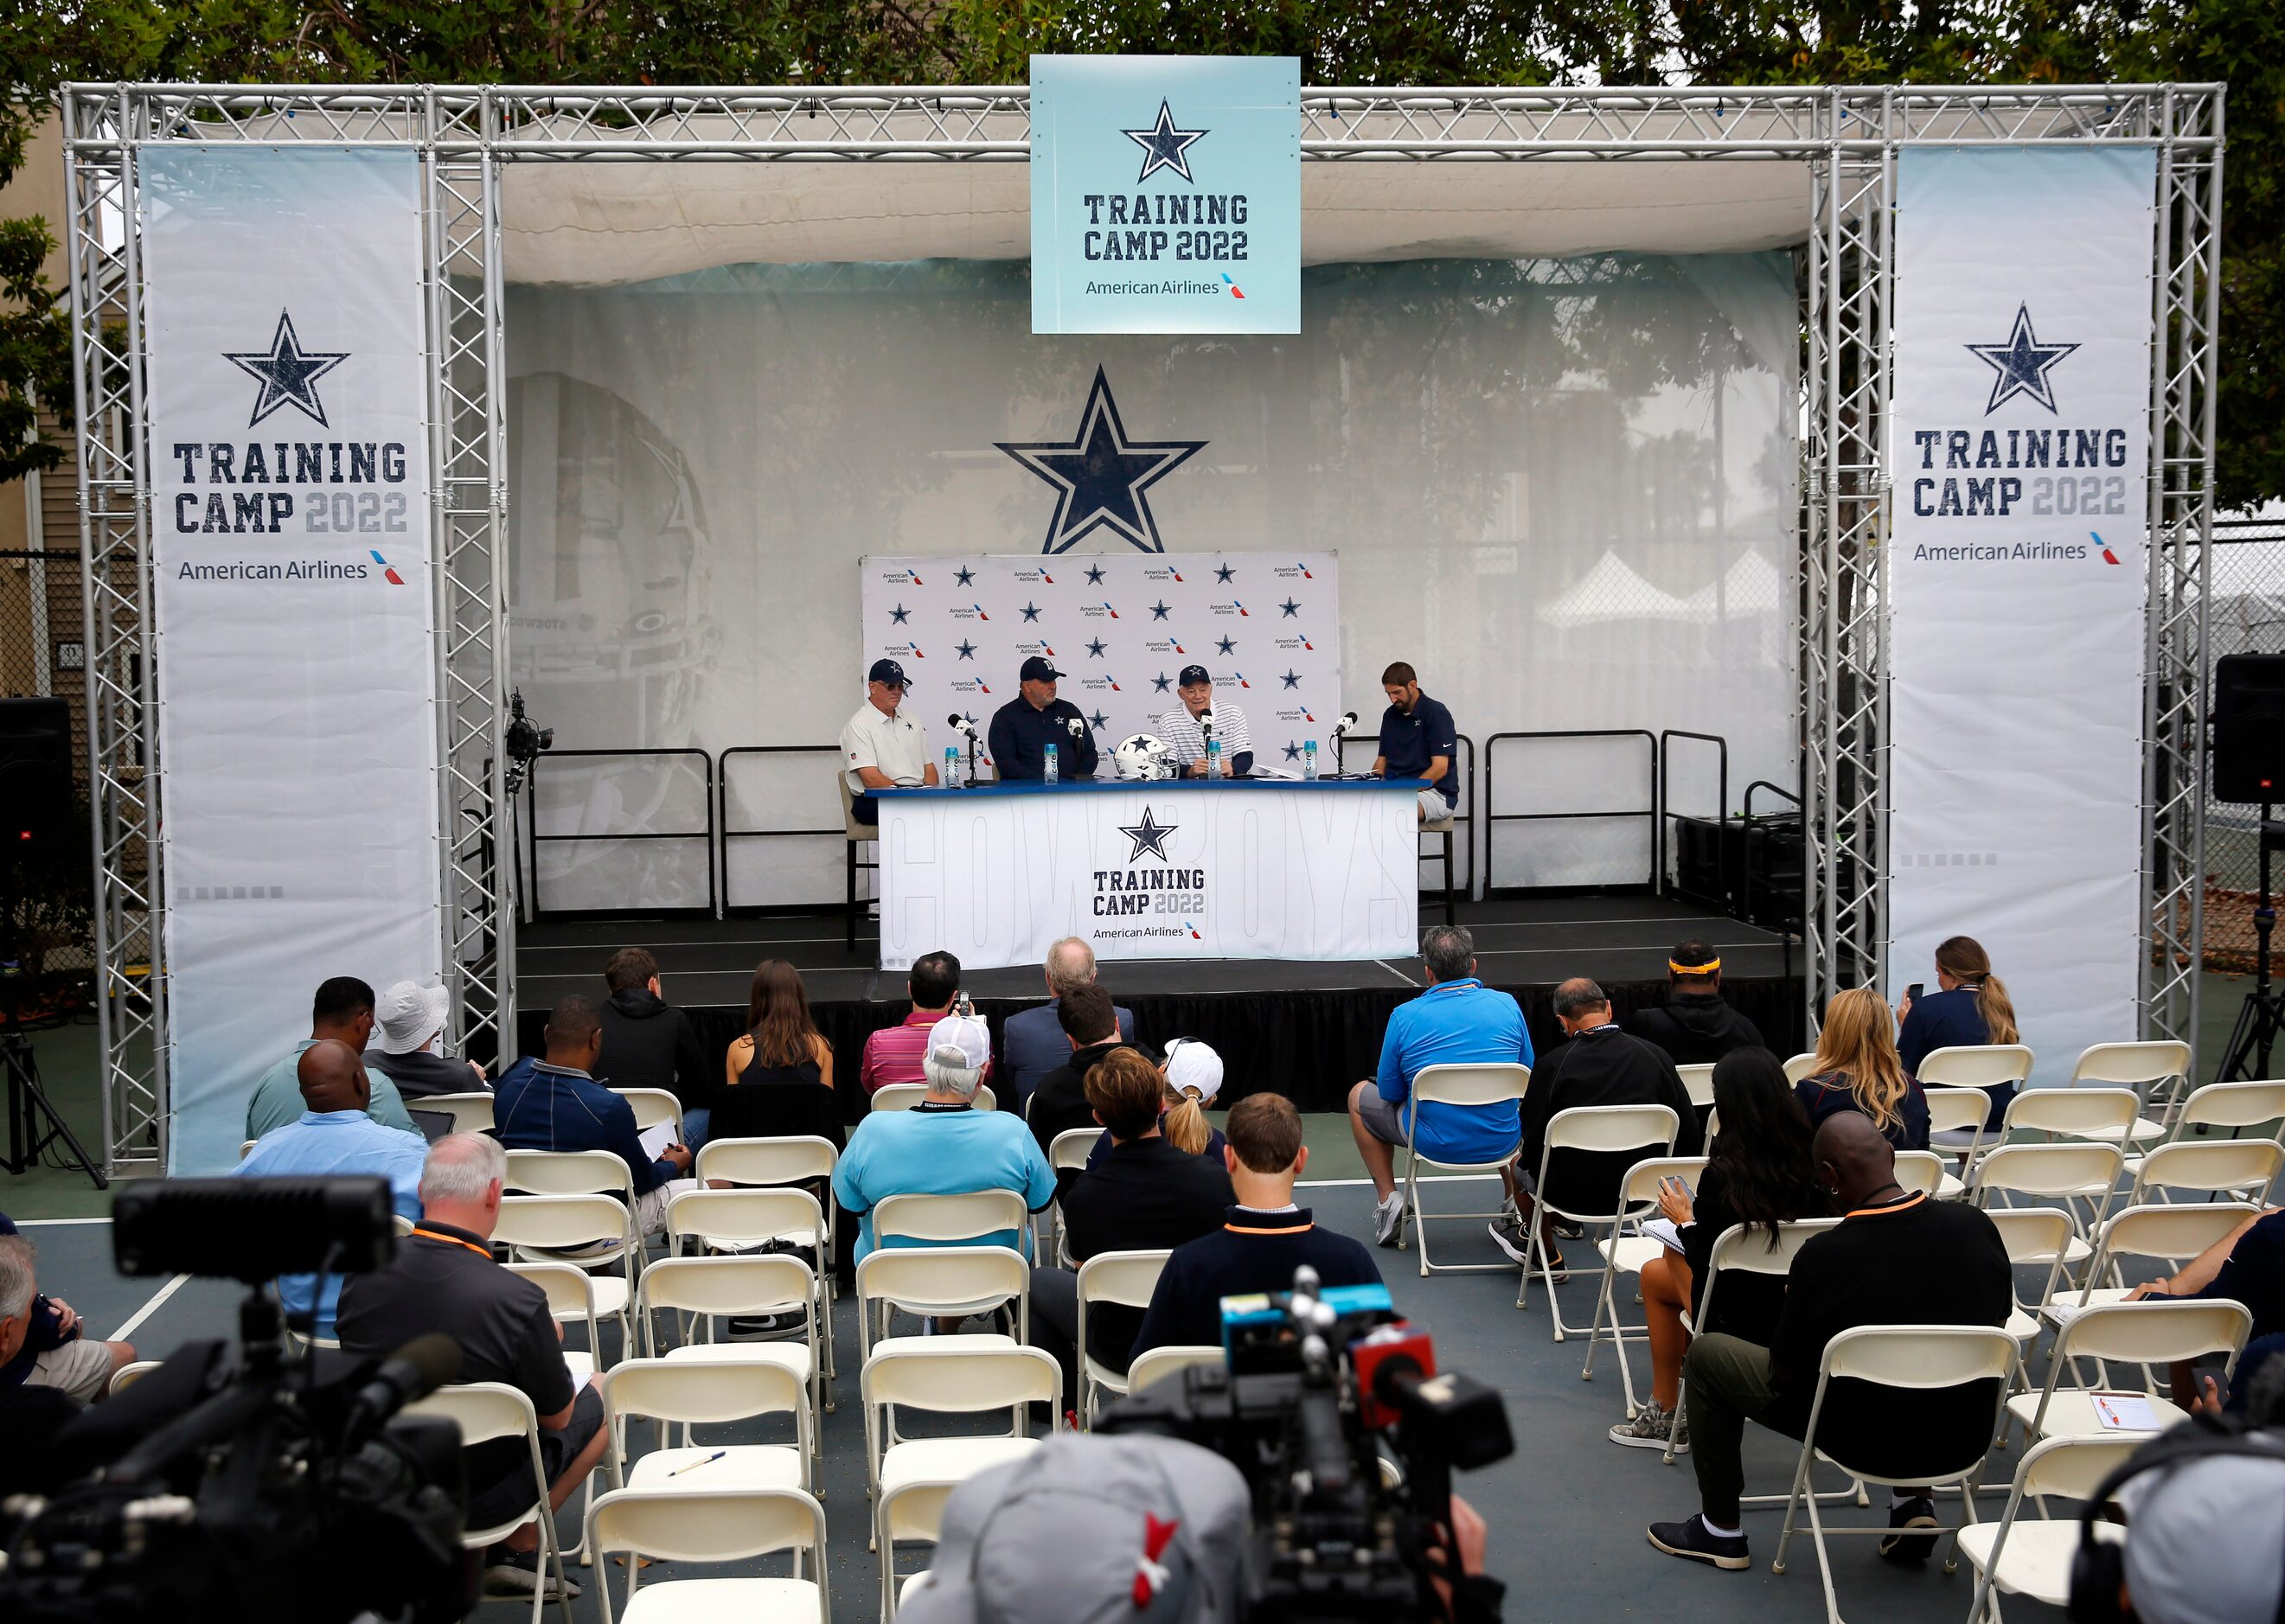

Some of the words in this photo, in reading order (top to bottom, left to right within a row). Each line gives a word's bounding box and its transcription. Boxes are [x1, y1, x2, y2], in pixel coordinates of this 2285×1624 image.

[1084, 194, 1248, 225] TRAINING
[1084, 230, 1168, 261] CAMP
[1175, 230, 1248, 261] 2022
[1085, 280, 1159, 295] American
[1161, 279, 1219, 295] Airlines
[1914, 428, 2127, 470] TRAINING
[173, 442, 406, 484] TRAINING
[1913, 476, 2022, 517] CAMP
[2032, 475, 2127, 516] 2022
[175, 492, 294, 534] CAMP
[304, 491, 407, 534] 2022
[1913, 542, 2008, 561] American
[2011, 541, 2087, 560] Airlines
[178, 560, 282, 580] American
[285, 559, 368, 579] Airlines
[1093, 869, 1205, 892] TRAINING
[1093, 894, 1150, 917] CAMP
[1154, 893, 1205, 914] 2022
[1092, 929, 1142, 939] American
[1143, 927, 1184, 937] Airlines
